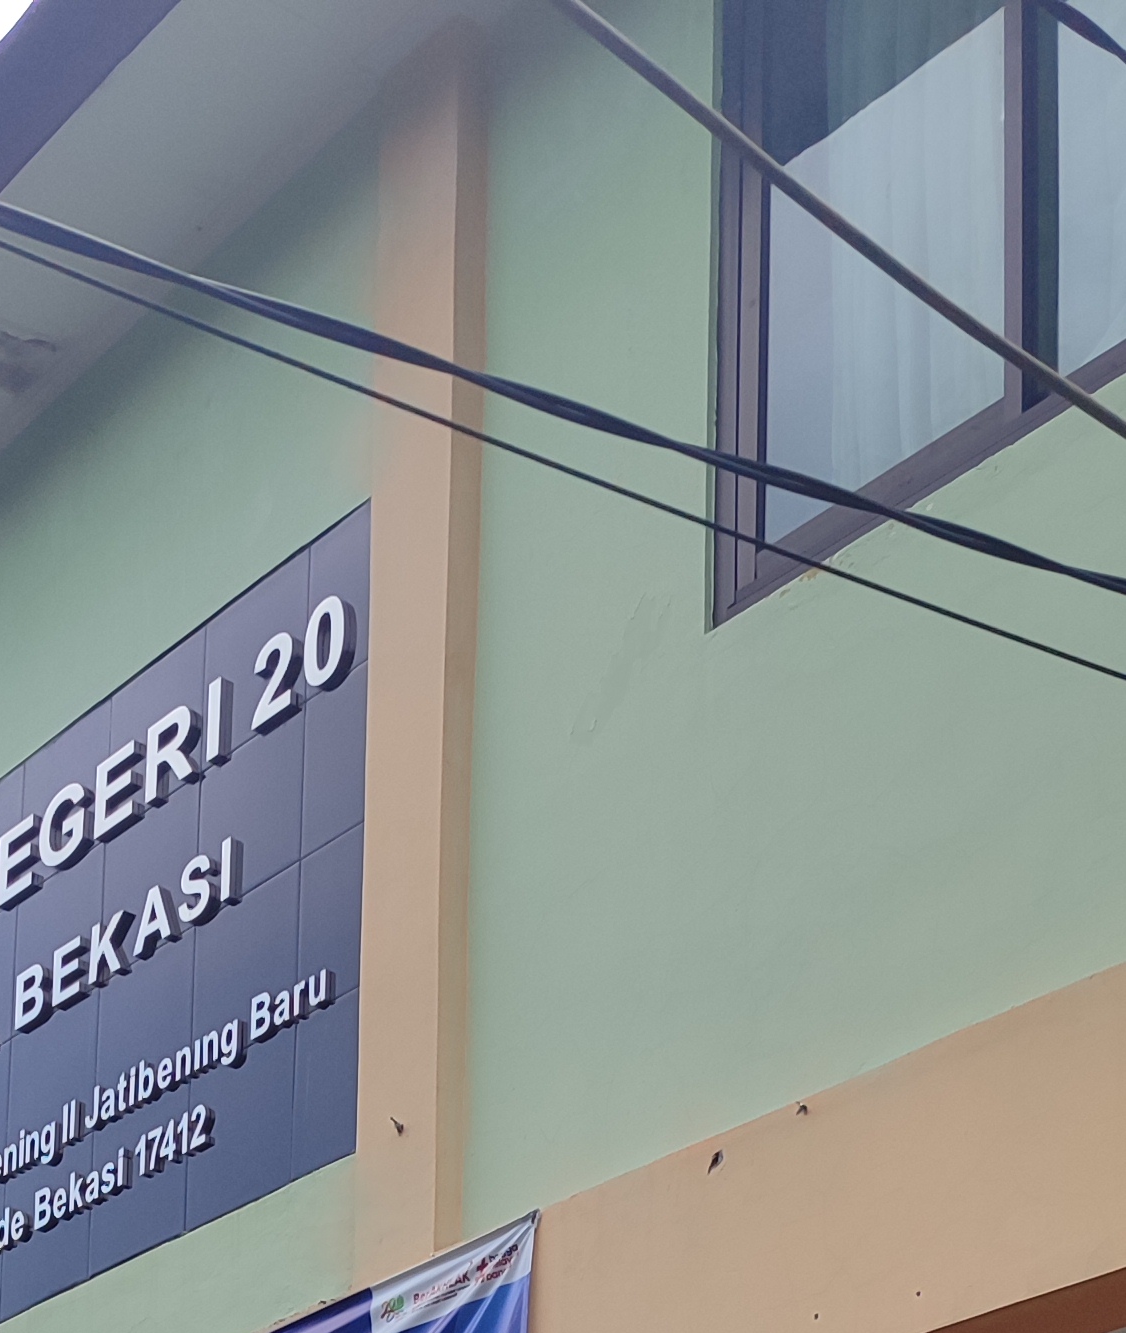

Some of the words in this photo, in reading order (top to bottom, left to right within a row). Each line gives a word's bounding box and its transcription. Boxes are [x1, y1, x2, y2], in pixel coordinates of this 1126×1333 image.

[251, 594, 352, 733] 20
[14, 835, 239, 1033] BEKASI
[85, 1019, 242, 1130] Jatibening
[251, 968, 331, 1041] Baru
[34, 1147, 127, 1231] Bekasi
[135, 1104, 210, 1177] 17412
